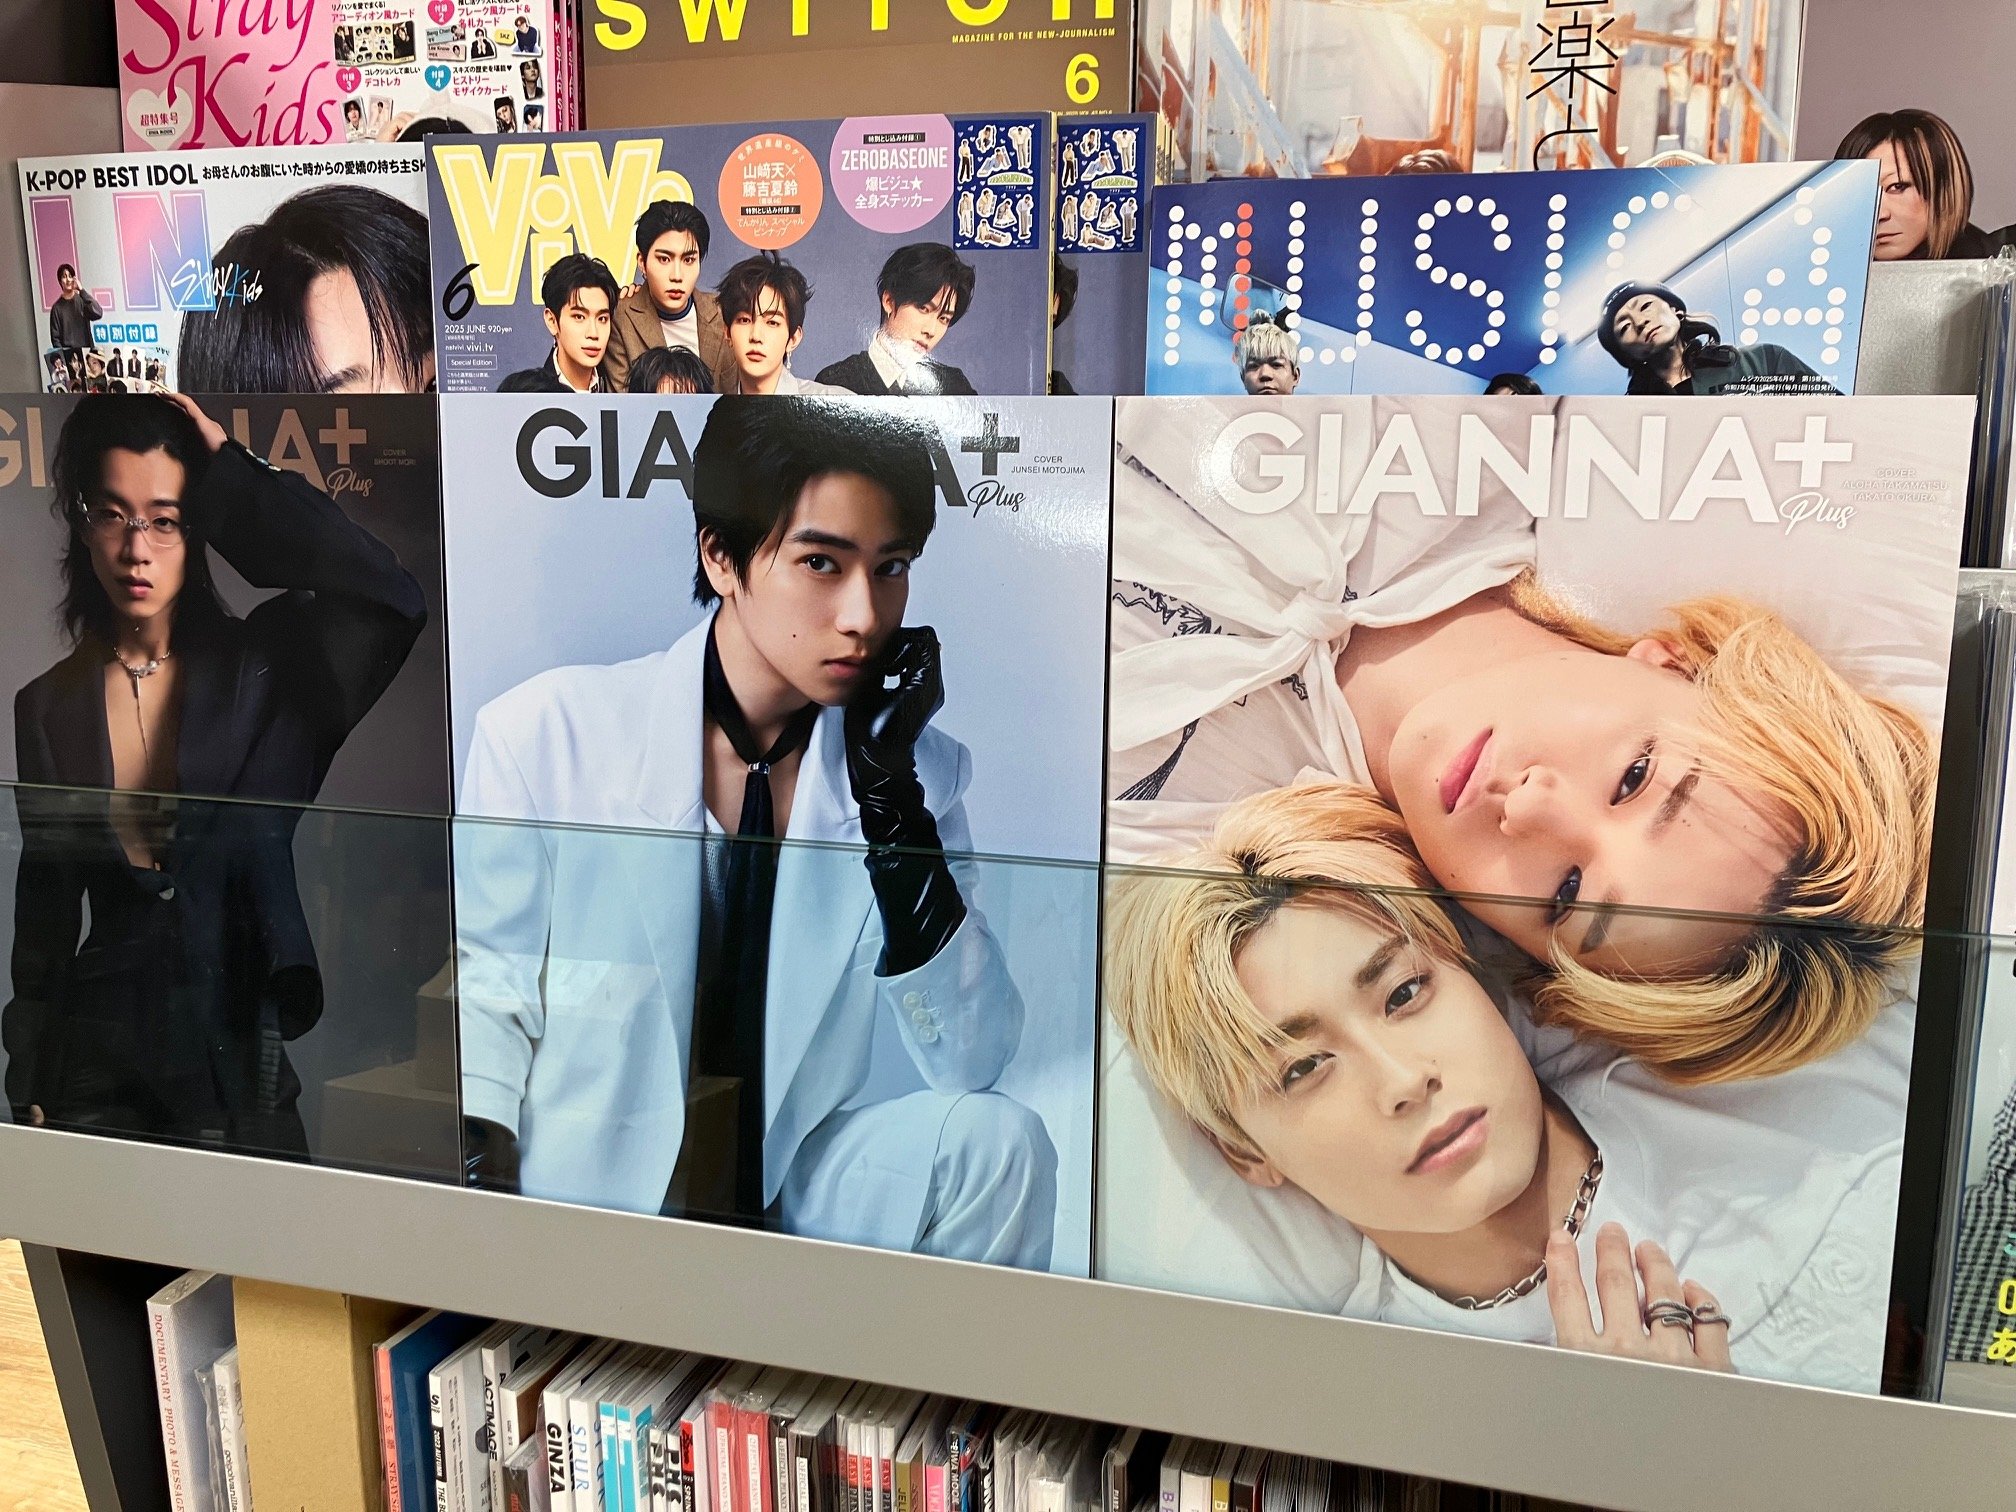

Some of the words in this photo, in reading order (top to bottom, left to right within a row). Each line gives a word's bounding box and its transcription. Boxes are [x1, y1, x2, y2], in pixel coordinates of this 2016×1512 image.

[952, 32, 995, 43] MAGAZINE
[998, 32, 1014, 41] FOR
[1018, 31, 1033, 40] THE
[1037, 27, 1116, 39] NEW-JOURNALISM
[452, 75, 490, 85] ヒストリー
[453, 85, 508, 96] モザイクカード
[1065, 53, 1100, 104] 6
[1526, 0, 1619, 170] 楽と
[167, 53, 337, 150] Kids
[140, 112, 179, 127] 超特集号
[841, 146, 949, 171] ZEROBASEONE
[25, 168, 87, 192] K-POP
[93, 166, 139, 188] BEST
[146, 163, 199, 186] IDOL
[855, 192, 934, 209] 全身ステッカー
[171, 258, 233, 319] Stray
[226, 262, 264, 308] Kids
[442, 263, 480, 321] 6
[444, 325, 465, 334] 2025
[466, 325, 486, 334] JUNE
[466, 342, 494, 351] vivi.tv
[451, 359, 472, 367] Special
[1011, 466, 1040, 474] JUNSEI
[1042, 466, 1086, 474] MOTOJIMA
[1877, 468, 1917, 478] COVER
[326, 467, 375, 501] Plus
[1843, 480, 1879, 489] ALOHA
[1882, 480, 1948, 490] TAKAMATSU
[967, 480, 1027, 518] Plus
[1853, 492, 1894, 502] TAKATO
[1895, 492, 1937, 503] OKURA
[1779, 491, 1857, 536] Plus
[154, 1314, 171, 1402] DOCUMENTARY
[164, 1407, 177, 1445] PHOTO
[546, 1422, 566, 1494] GINZA
[572, 1424, 589, 1491] SPUR
